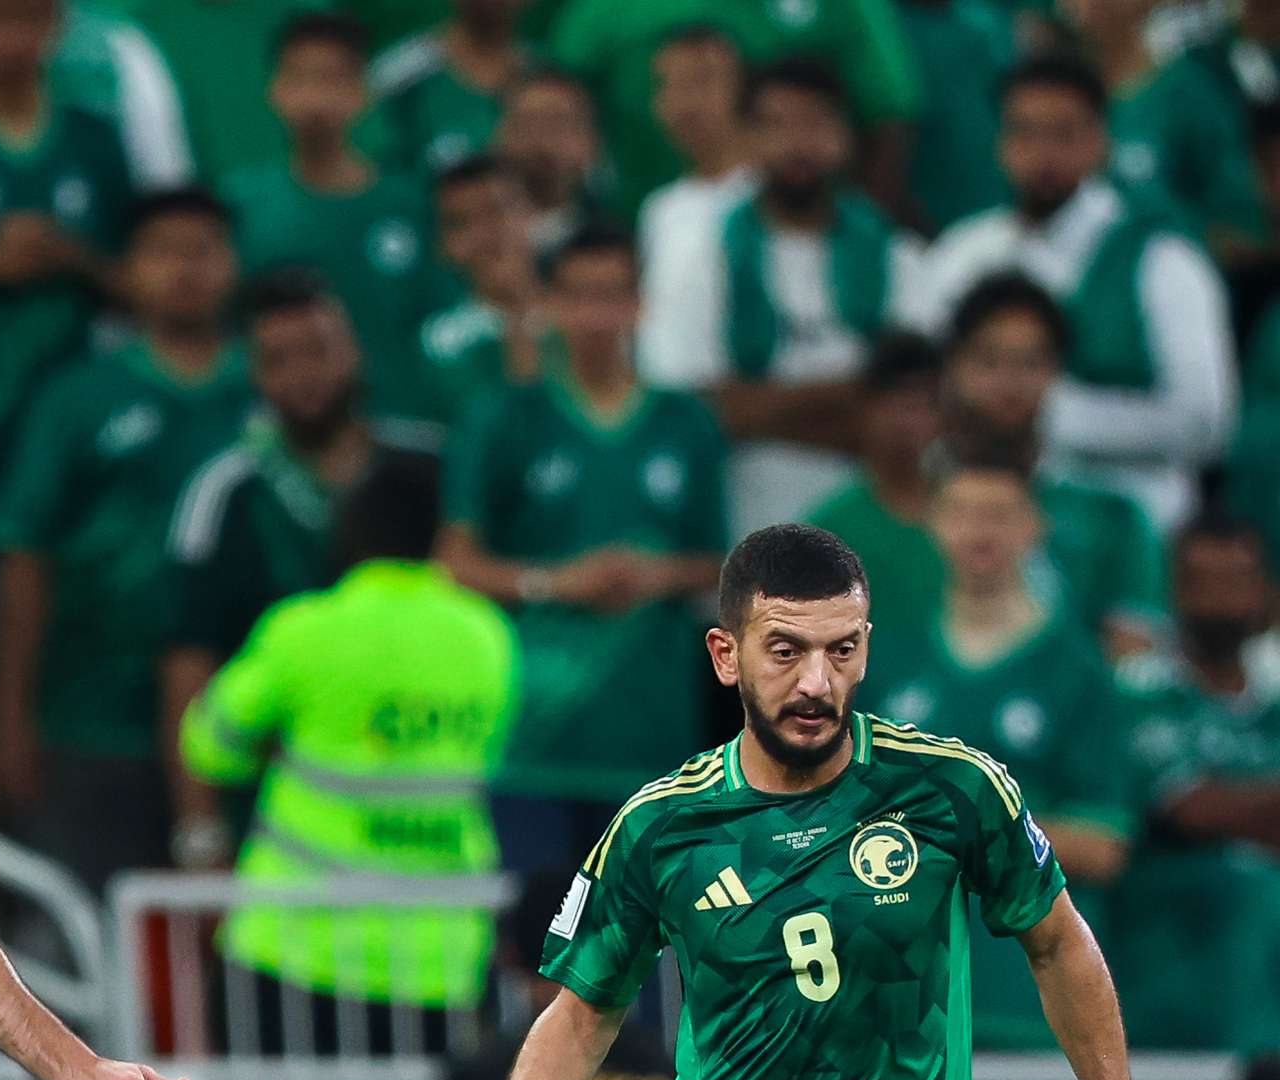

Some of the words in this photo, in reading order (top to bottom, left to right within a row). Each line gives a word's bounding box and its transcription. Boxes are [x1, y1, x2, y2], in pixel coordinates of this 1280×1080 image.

[887, 859, 907, 869] SAFF
[873, 892, 910, 906] SAUDI
[782, 911, 841, 1003] 8
